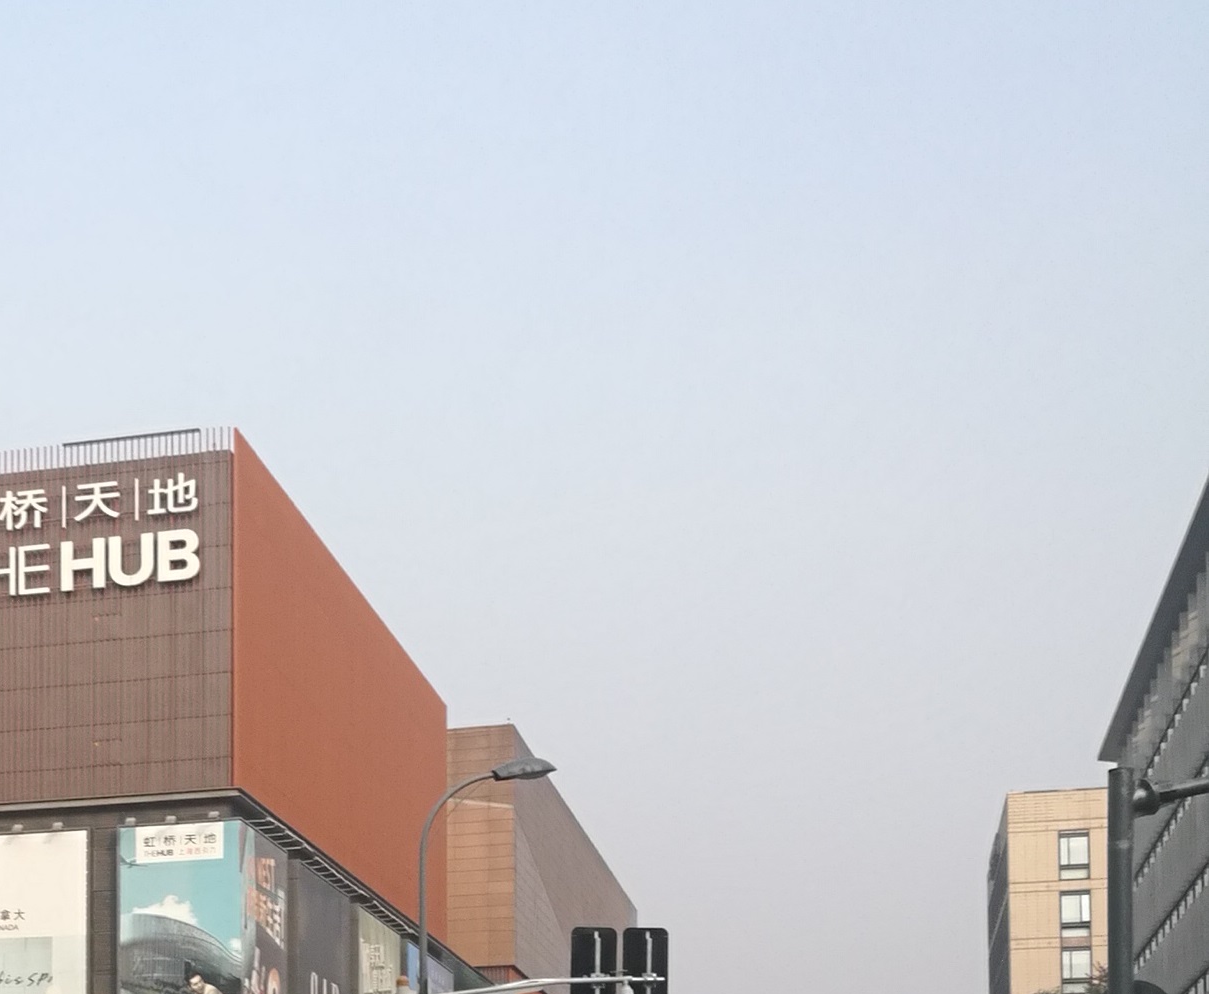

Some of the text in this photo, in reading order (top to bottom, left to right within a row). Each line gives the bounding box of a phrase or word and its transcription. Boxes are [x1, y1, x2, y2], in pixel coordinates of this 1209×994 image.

[60, 528, 200, 592] HUB
[143, 832, 217, 848] 虹桥天地
